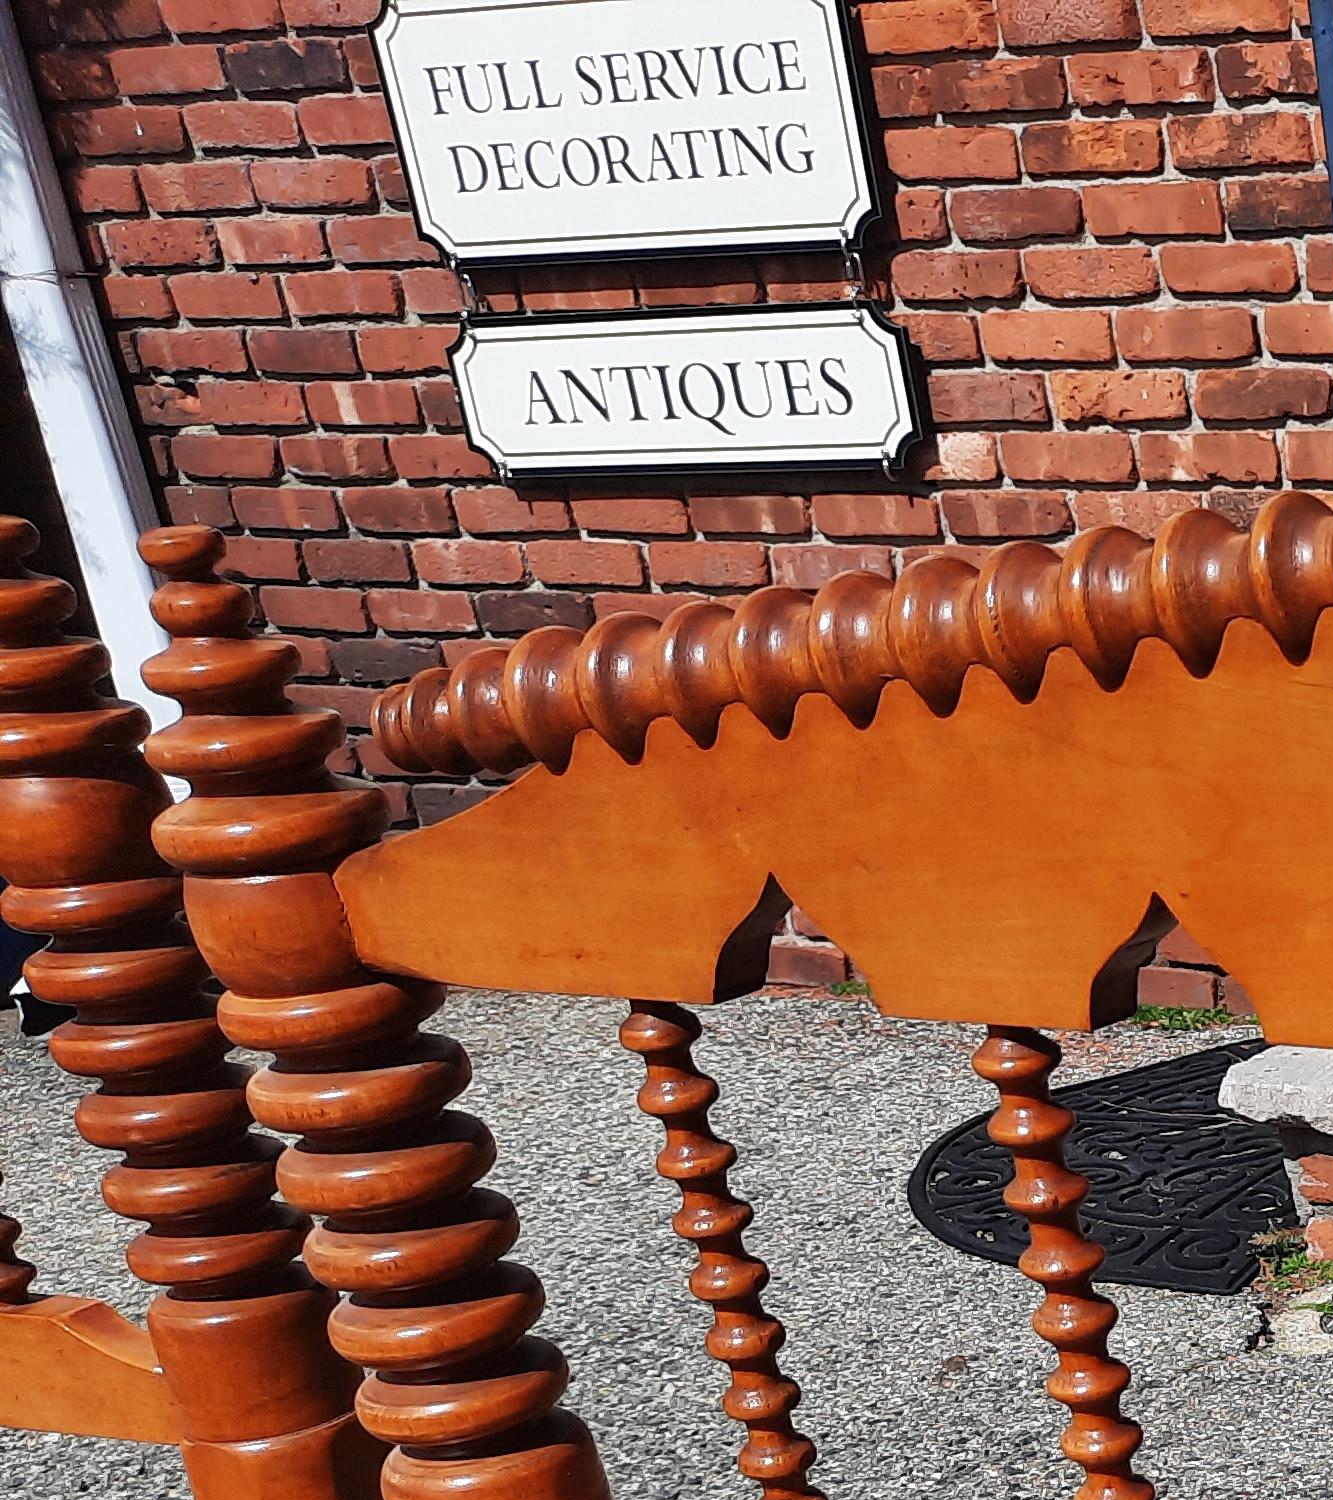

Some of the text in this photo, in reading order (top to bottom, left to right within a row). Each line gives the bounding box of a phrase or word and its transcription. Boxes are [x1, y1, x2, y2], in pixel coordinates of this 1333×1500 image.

[424, 40, 806, 115] FULL SERVICE
[447, 123, 814, 194] DECORATING
[525, 358, 854, 436] ANTIQUES
